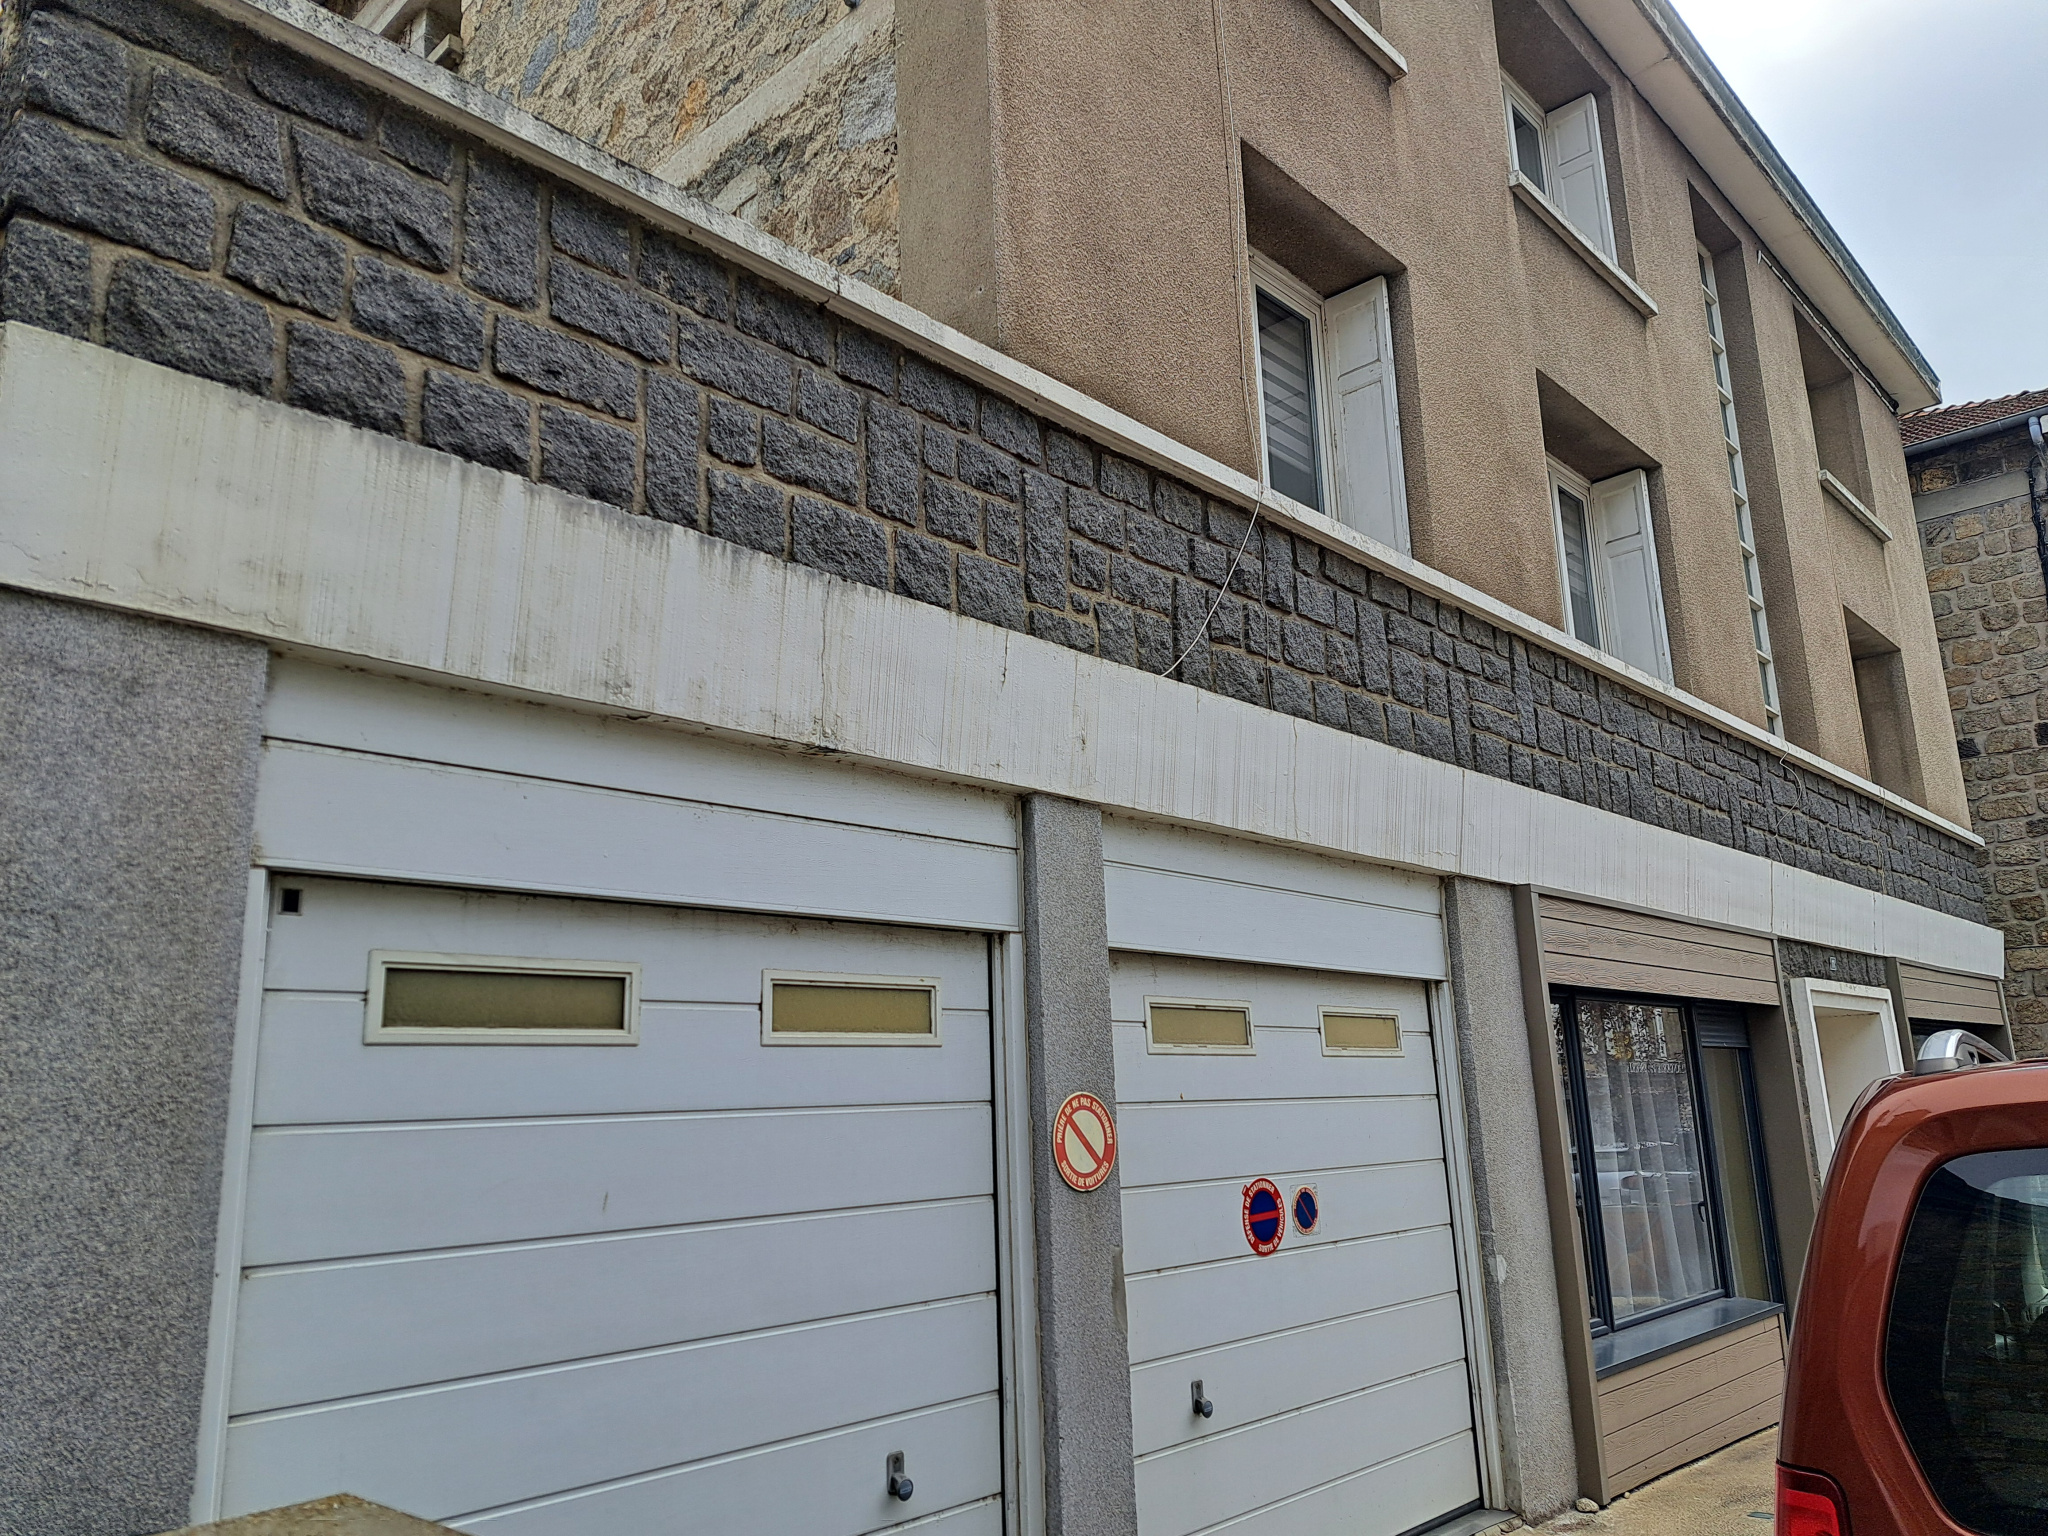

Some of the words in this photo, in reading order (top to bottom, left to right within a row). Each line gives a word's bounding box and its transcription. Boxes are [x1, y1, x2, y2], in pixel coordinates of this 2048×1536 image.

[1064, 1104, 1072, 1116] DE
[1072, 1099, 1079, 1109] NE
[1080, 1097, 1091, 1107] PAS
[1092, 1101, 1113, 1144] STATIONNER
[1061, 1160, 1078, 1184] SORTIE
[1077, 1177, 1085, 1186] DE
[1085, 1161, 1109, 1187] VOITURES
[1245, 1196, 1251, 1207] DE
[1249, 1181, 1275, 1197] STATIONNER
[1258, 1244, 1274, 1253] SORTIE
[1273, 1236, 1279, 1247] DE
